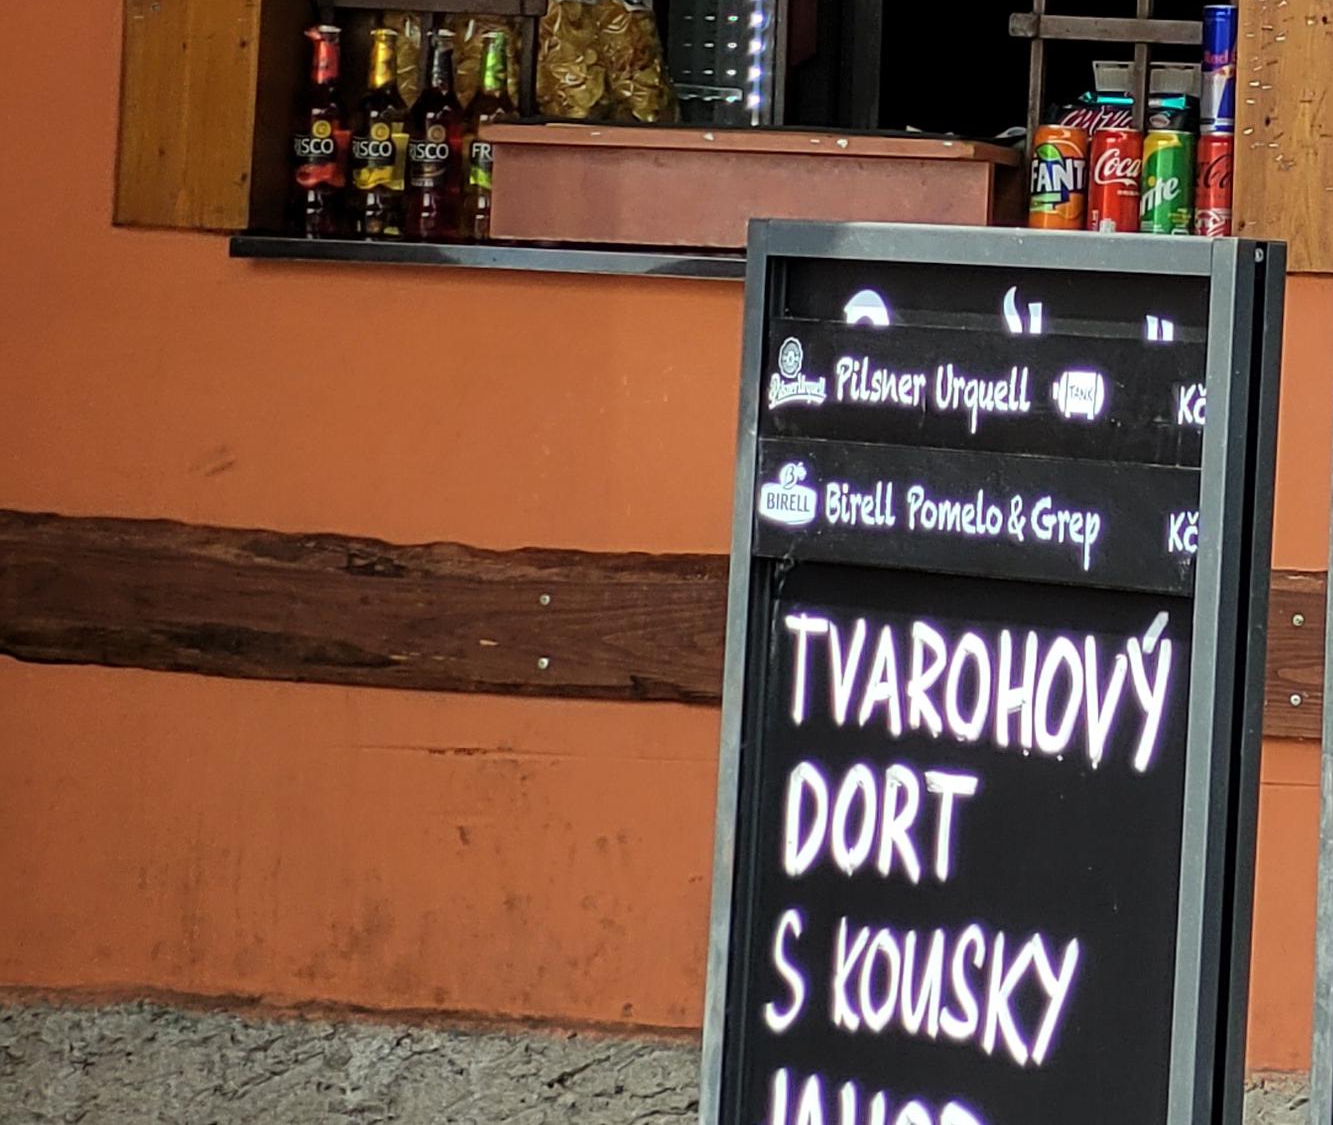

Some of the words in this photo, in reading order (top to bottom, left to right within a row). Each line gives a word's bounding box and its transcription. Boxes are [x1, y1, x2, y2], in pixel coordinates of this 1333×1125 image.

[1030, 158, 1087, 193] FANT
[836, 355, 927, 409] Pilsner
[935, 363, 1031, 435] Urquell
[766, 490, 811, 514] BIRELL
[825, 480, 897, 528] Birell
[906, 484, 1004, 535] Pomelo
[1031, 496, 1101, 572] Grep
[784, 611, 1173, 773] TVAROHOVÝ
[784, 761, 979, 886] DORT
[764, 909, 805, 1034] S
[832, 915, 1081, 1067] KOUSKY
